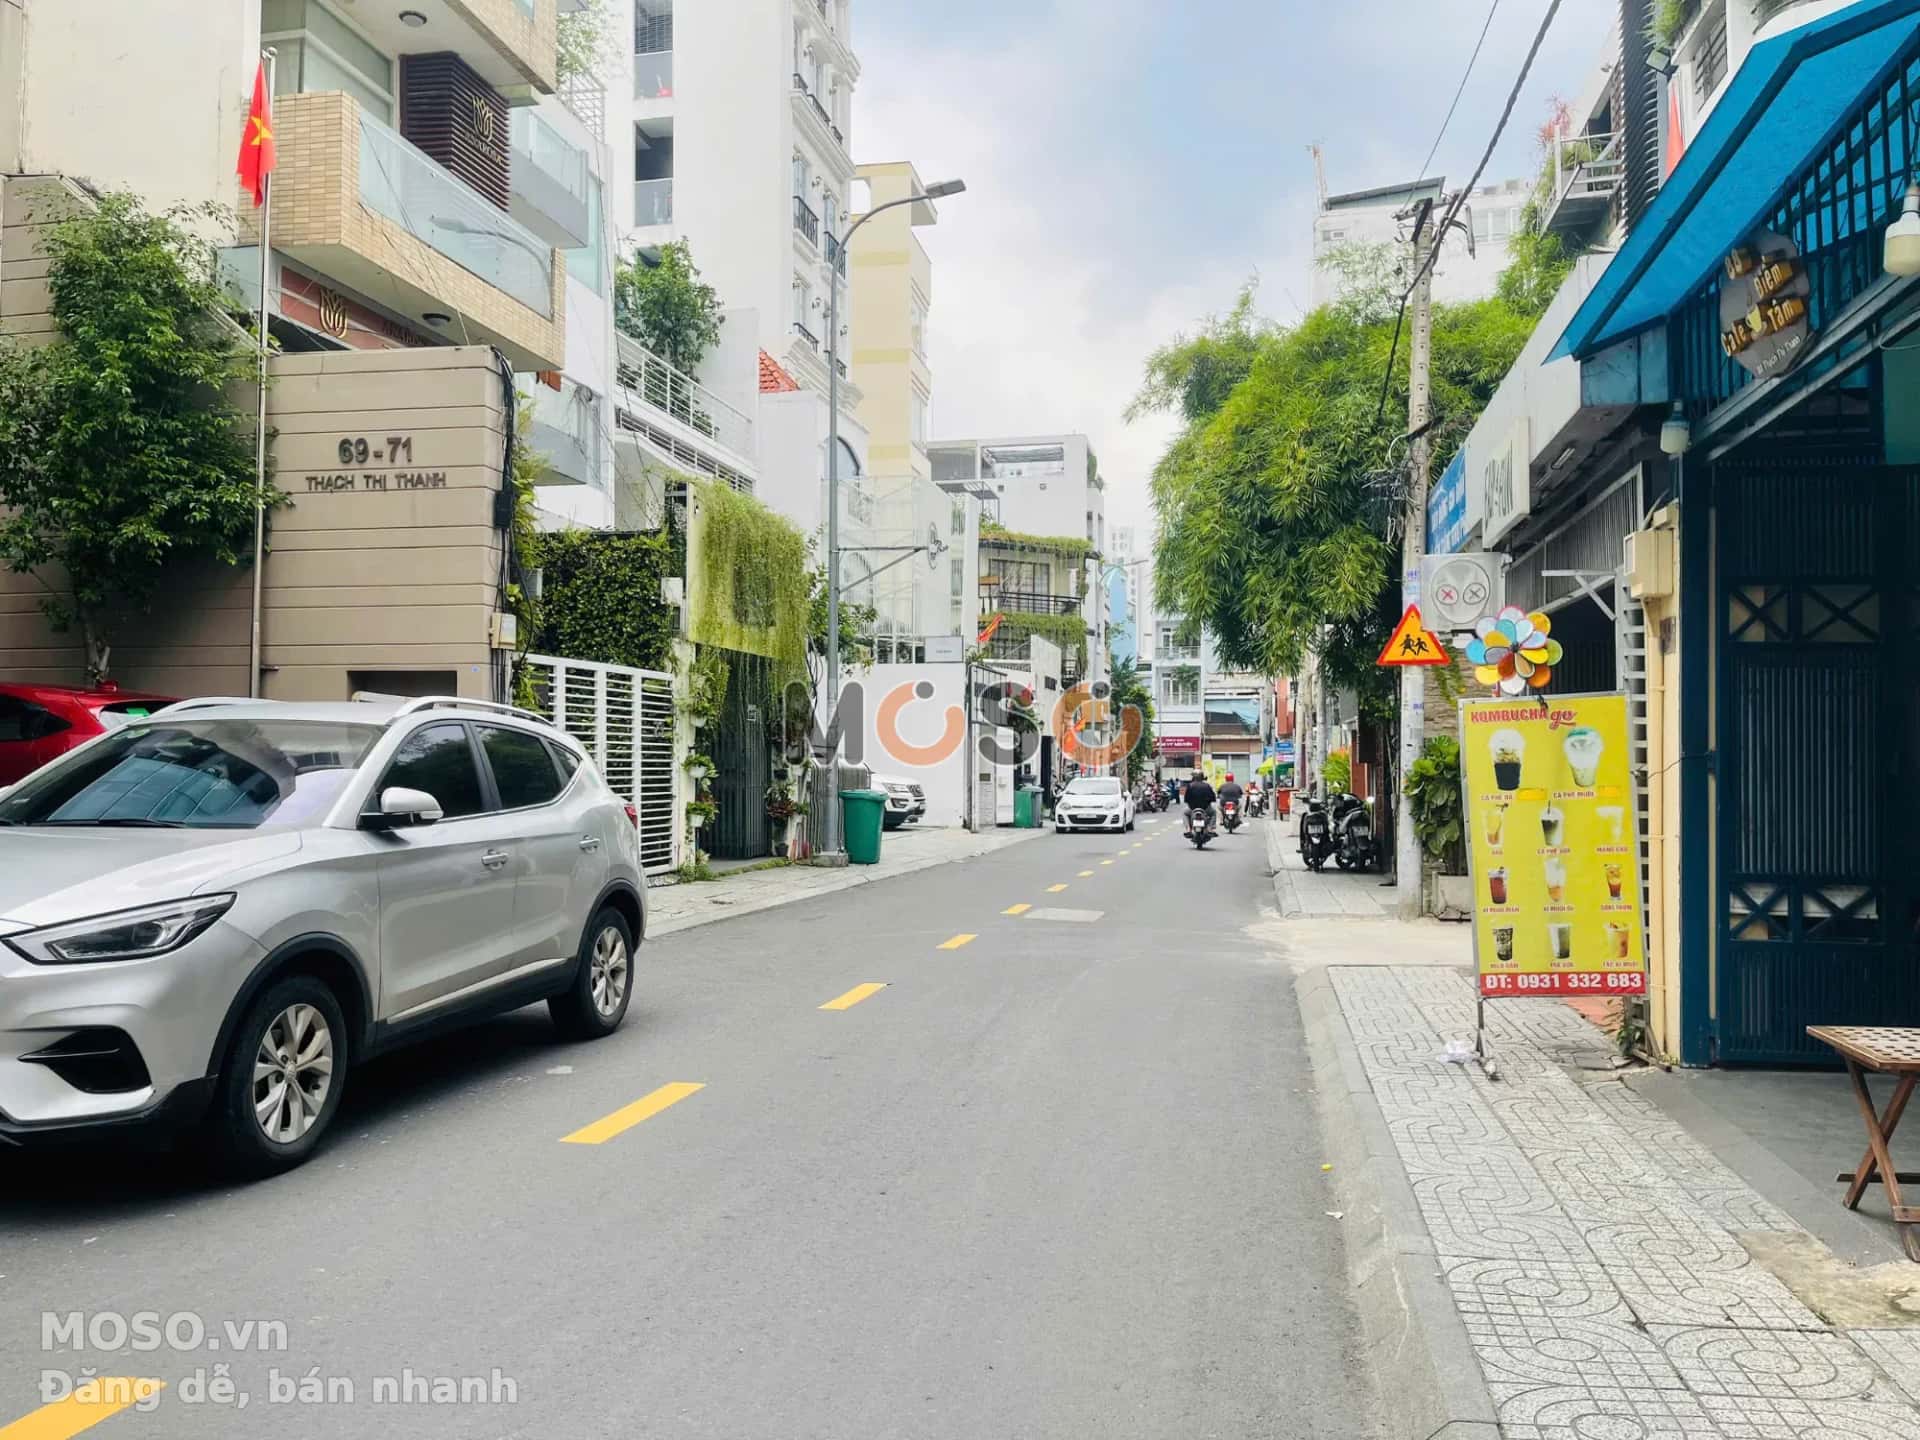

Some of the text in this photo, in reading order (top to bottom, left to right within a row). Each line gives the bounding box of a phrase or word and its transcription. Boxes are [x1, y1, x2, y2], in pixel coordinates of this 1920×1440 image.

[1721, 322, 1747, 357] Cafe
[305, 472, 447, 493] THẠCH THỊ THANH
[1471, 707, 1547, 723] KOMBUCHA
[1517, 973, 1560, 989] 0931
[1568, 973, 1602, 988] 332
[1607, 972, 1643, 988] 683
